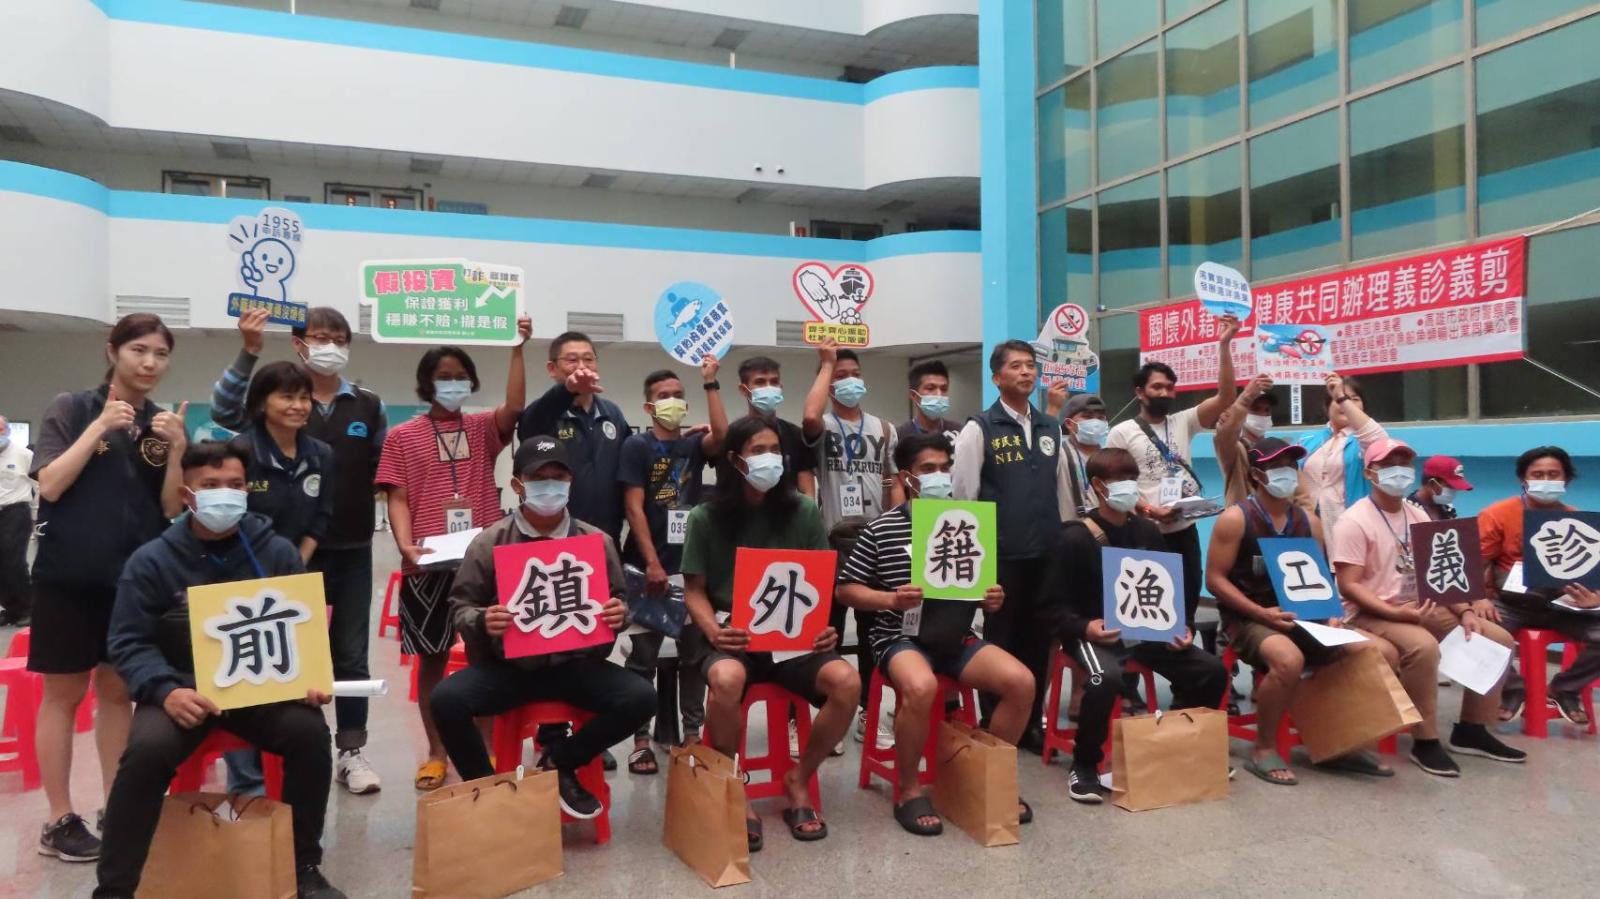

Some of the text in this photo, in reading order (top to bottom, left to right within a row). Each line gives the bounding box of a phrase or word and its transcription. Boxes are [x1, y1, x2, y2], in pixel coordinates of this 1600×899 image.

[262, 213, 300, 233] 1955
[373, 268, 457, 295] 假投資
[1148, 246, 1511, 347] 關懷外籍健康共同辦理義診義剪
[405, 296, 468, 312] 保證獲利
[808, 334, 866, 344] 杜絕口販運
[826, 432, 886, 461] BOY
[991, 434, 1023, 451] 移民署
[995, 450, 1025, 465] NIA
[843, 496, 861, 508] 034
[450, 521, 470, 534] 017
[929, 519, 982, 583] 籍
[1429, 531, 1469, 591] 義
[1538, 523, 1599, 575] 診
[1285, 560, 1326, 592] 工
[513, 557, 603, 634] 鎮
[749, 570, 820, 642] 外
[1117, 569, 1172, 627] 漁
[218, 595, 302, 679] 前
